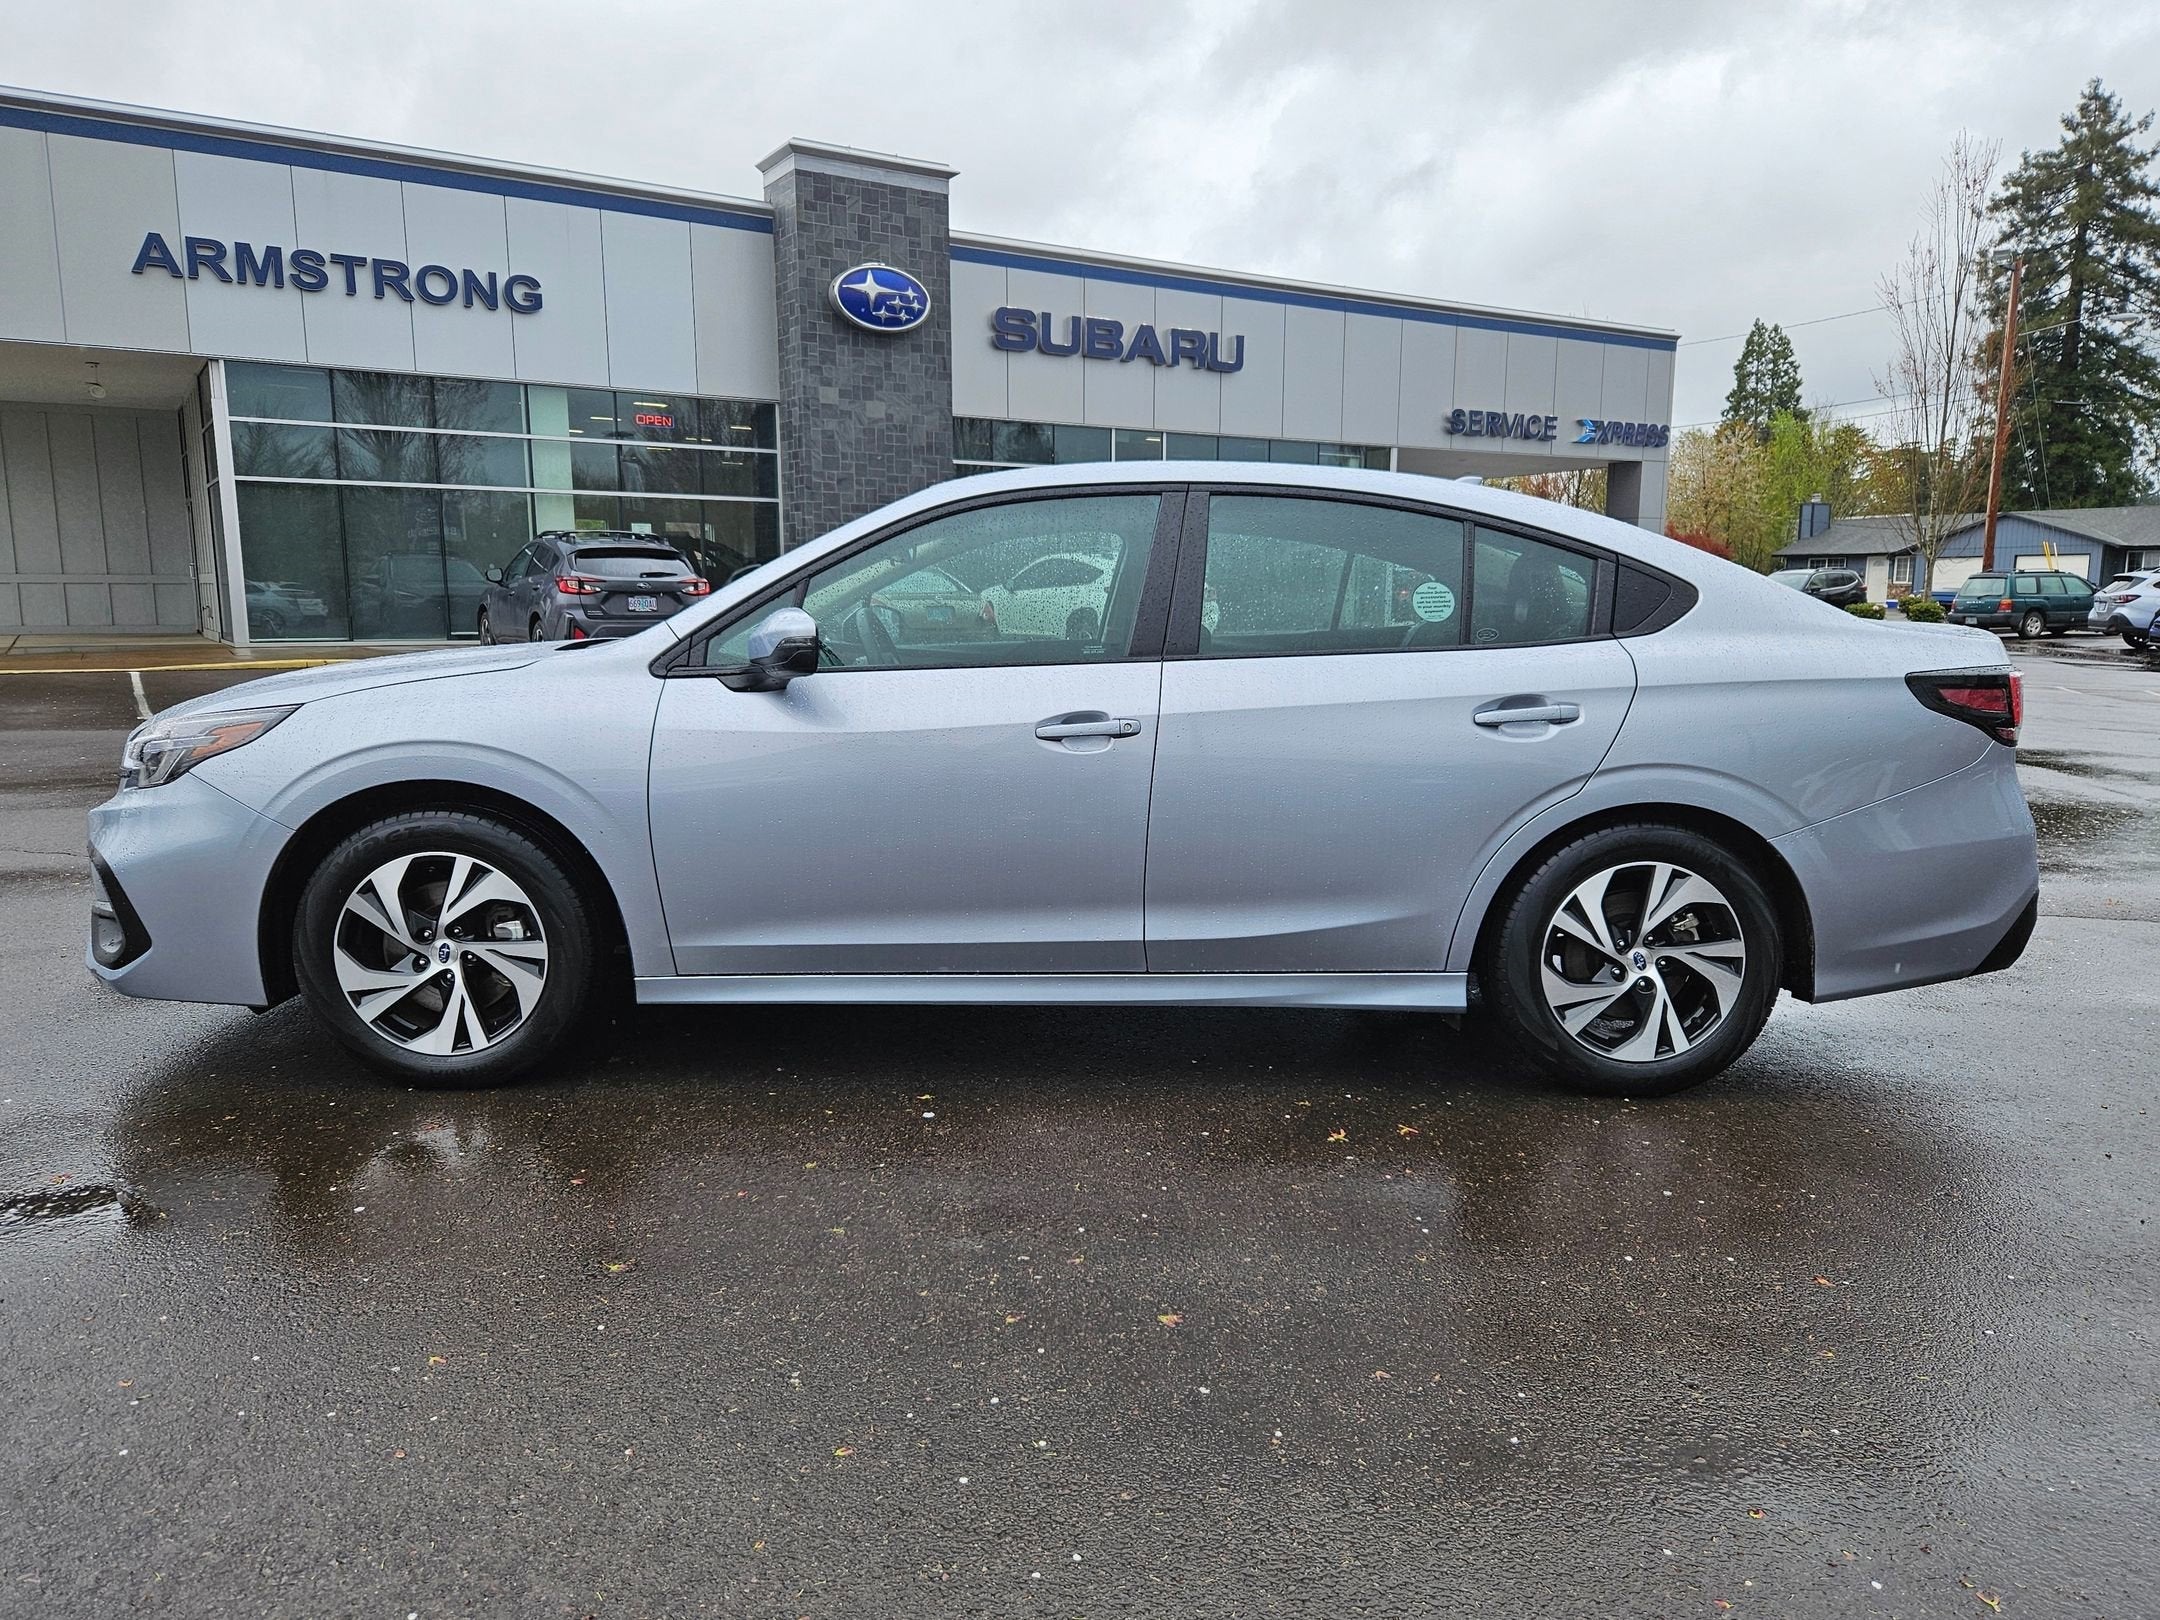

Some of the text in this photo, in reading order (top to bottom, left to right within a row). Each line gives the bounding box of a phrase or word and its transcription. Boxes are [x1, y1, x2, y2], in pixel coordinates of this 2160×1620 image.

[131, 231, 544, 314] ARMSTRONG
[992, 306, 1246, 373] SUBARU
[635, 414, 672, 426] OPEN
[1448, 408, 1671, 448] SERVICE EXPRESS
